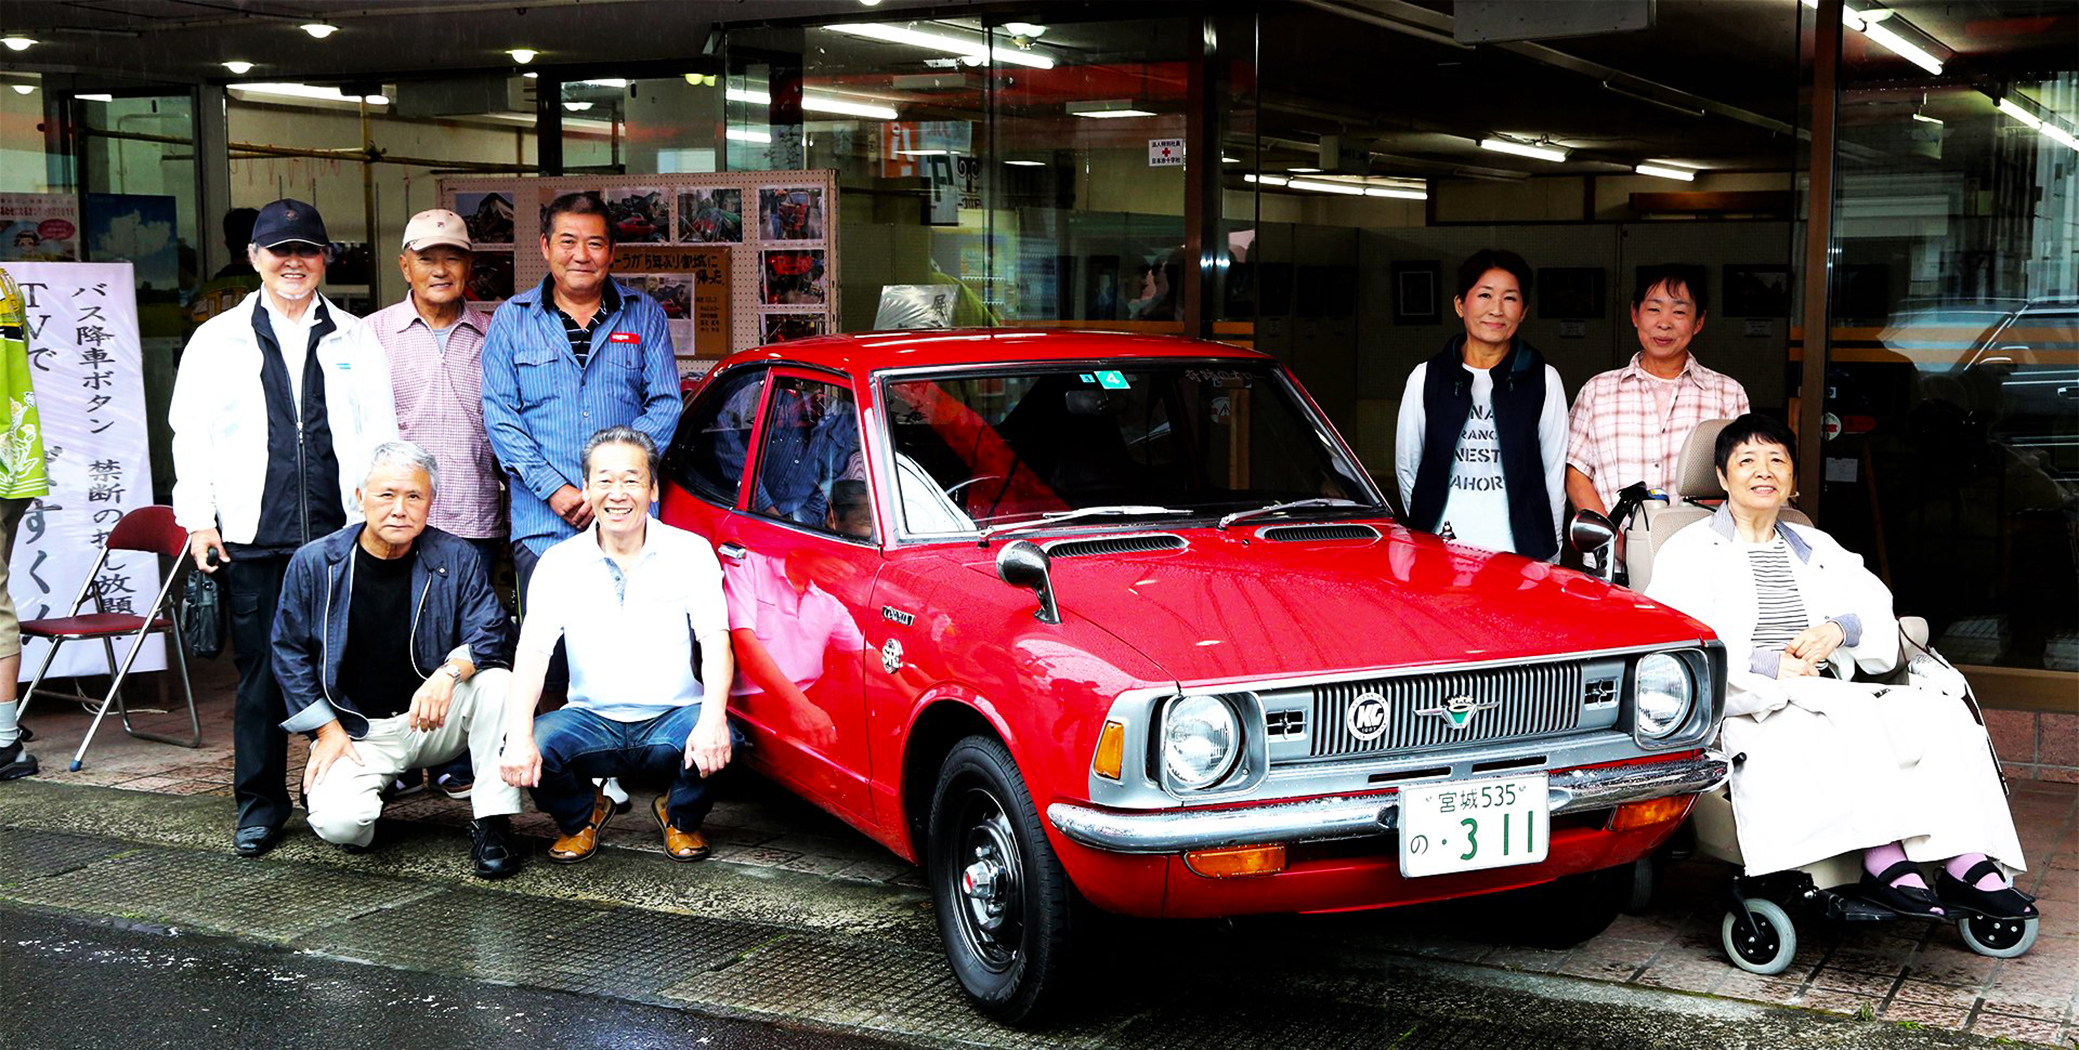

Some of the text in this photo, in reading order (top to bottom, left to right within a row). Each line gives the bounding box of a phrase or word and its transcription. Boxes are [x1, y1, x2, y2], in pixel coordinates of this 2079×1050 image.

[72, 283, 116, 434] バス降車ボタン
[1450, 474, 1506, 491] AHOR
